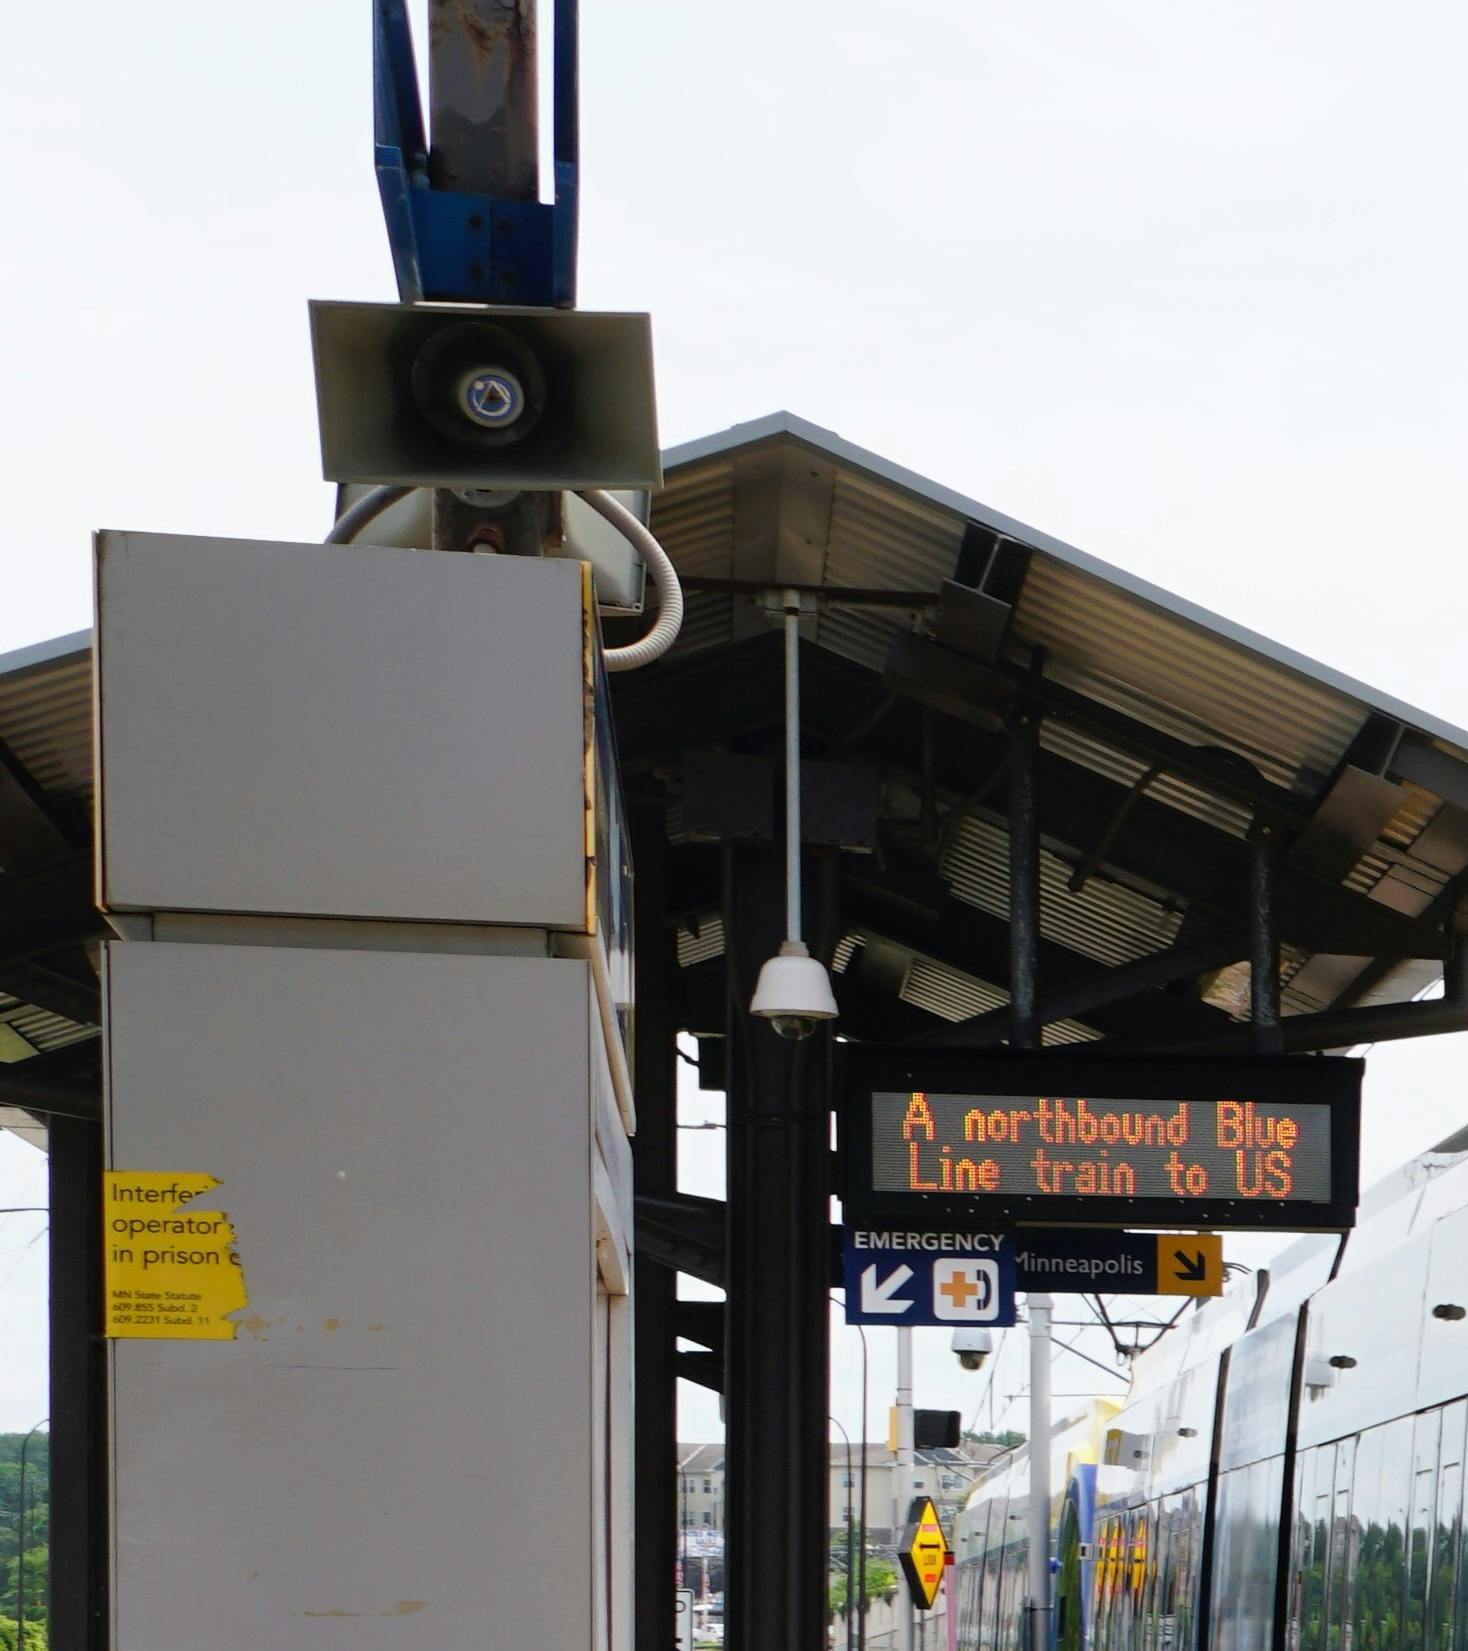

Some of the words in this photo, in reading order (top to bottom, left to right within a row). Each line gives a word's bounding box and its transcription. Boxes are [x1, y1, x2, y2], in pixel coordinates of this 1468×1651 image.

[902, 1092, 935, 1141] A
[964, 1098, 1190, 1146] northbound
[1216, 1101, 1300, 1150] Blue
[908, 1142, 1001, 1192] Line
[1030, 1148, 1136, 1196] train
[1164, 1151, 1208, 1197] to
[1236, 1150, 1294, 1198] US
[854, 1231, 1005, 1252] EMERGENCY
[113, 1244, 134, 1263] in
[143, 1245, 220, 1270] prison
[112, 1291, 132, 1299] MN
[135, 1291, 162, 1300] State
[165, 1291, 202, 1301] Statute
